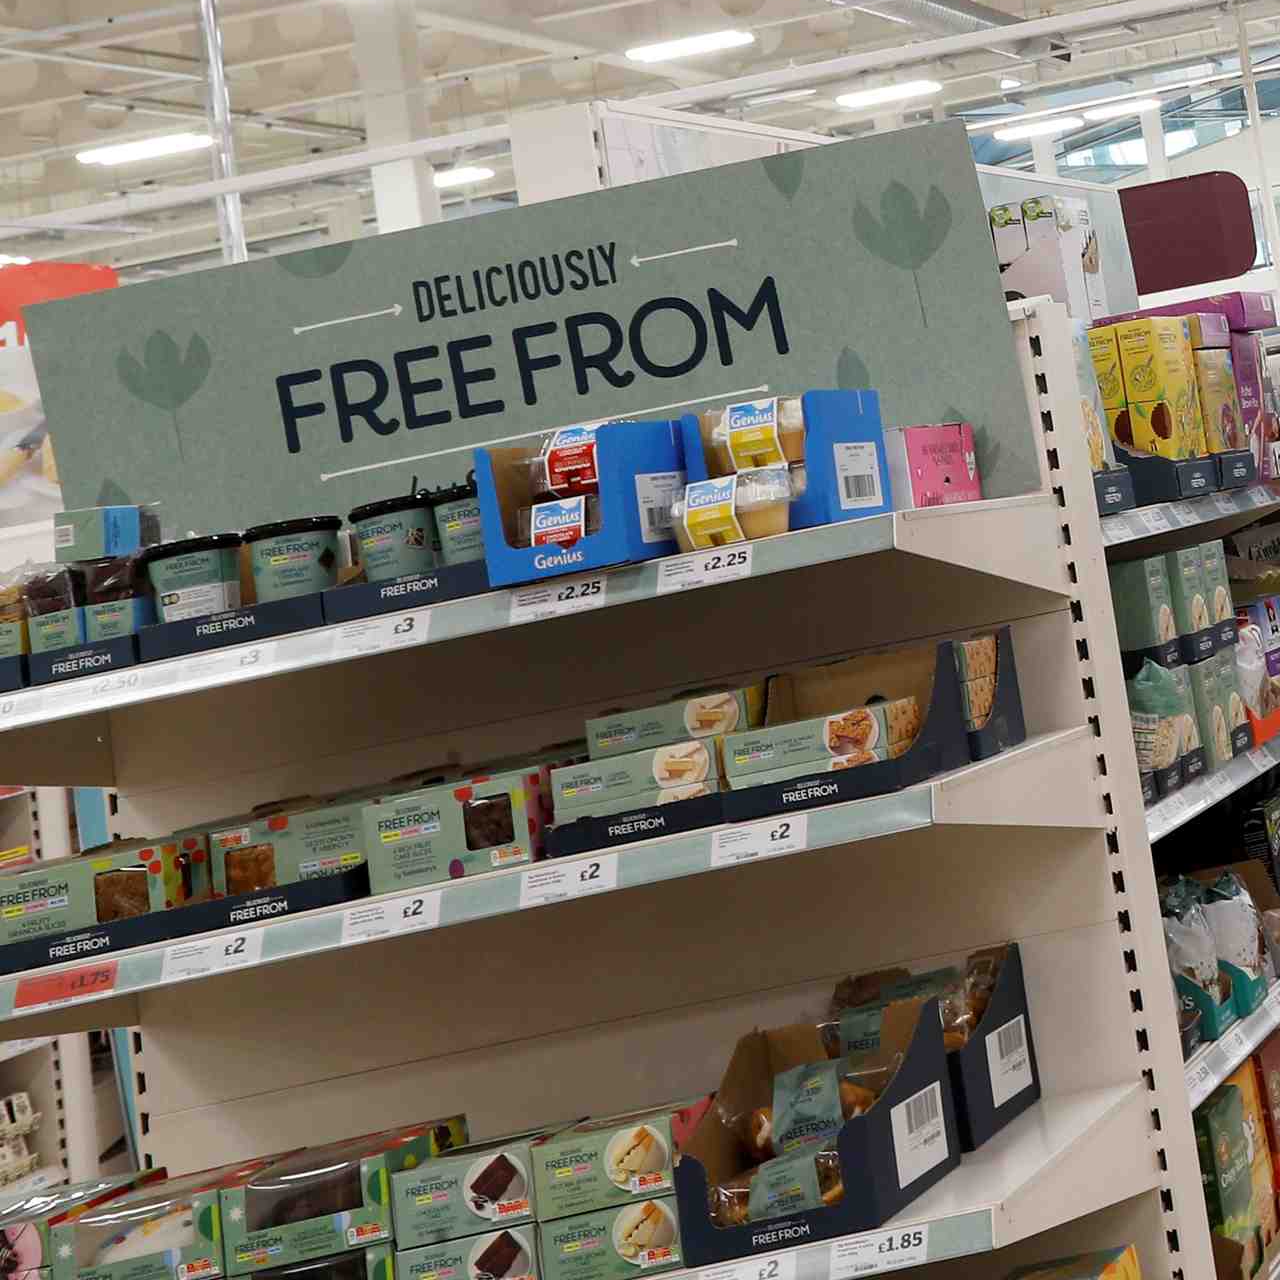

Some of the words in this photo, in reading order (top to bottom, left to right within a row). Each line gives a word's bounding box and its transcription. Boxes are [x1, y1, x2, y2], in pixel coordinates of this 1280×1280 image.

[410, 242, 620, 323] DELICIOUSLY
[275, 332, 503, 455] FREE
[510, 275, 791, 399] FROM
[730, 408, 774, 428] Genius
[687, 486, 732, 507] Genius
[534, 508, 582, 530] Genius
[534, 549, 585, 570] Genius
[703, 551, 748, 572] £2.25
[381, 580, 408, 600] FREE
[407, 576, 438, 595] FROM
[557, 581, 601, 603] £2.25
[195, 620, 222, 637] FREE
[222, 615, 255, 634] FROM
[393, 617, 415, 635] £3
[51, 658, 78, 676] FREE
[78, 653, 112, 672] FROM
[782, 786, 808, 804] FREE
[808, 782, 839, 800] FROM
[377, 815, 406, 832] FREE
[405, 808, 441, 827] FROM
[608, 819, 634, 837] FREE
[633, 815, 665, 833] FROM
[770, 823, 792, 842] £2
[579, 862, 601, 883] £2
[230, 904, 258, 922] FREE
[257, 899, 289, 918] FROM
[402, 898, 425, 920] £2
[49, 941, 77, 959] FREE
[76, 936, 110, 954] FROM
[223, 936, 247, 957] £2
[70, 969, 111, 990] £1.75
[752, 1227, 781, 1246] FREE
[780, 1222, 811, 1242] FROM
[878, 1230, 924, 1255] £1.85
[758, 1259, 780, 1280] £2
